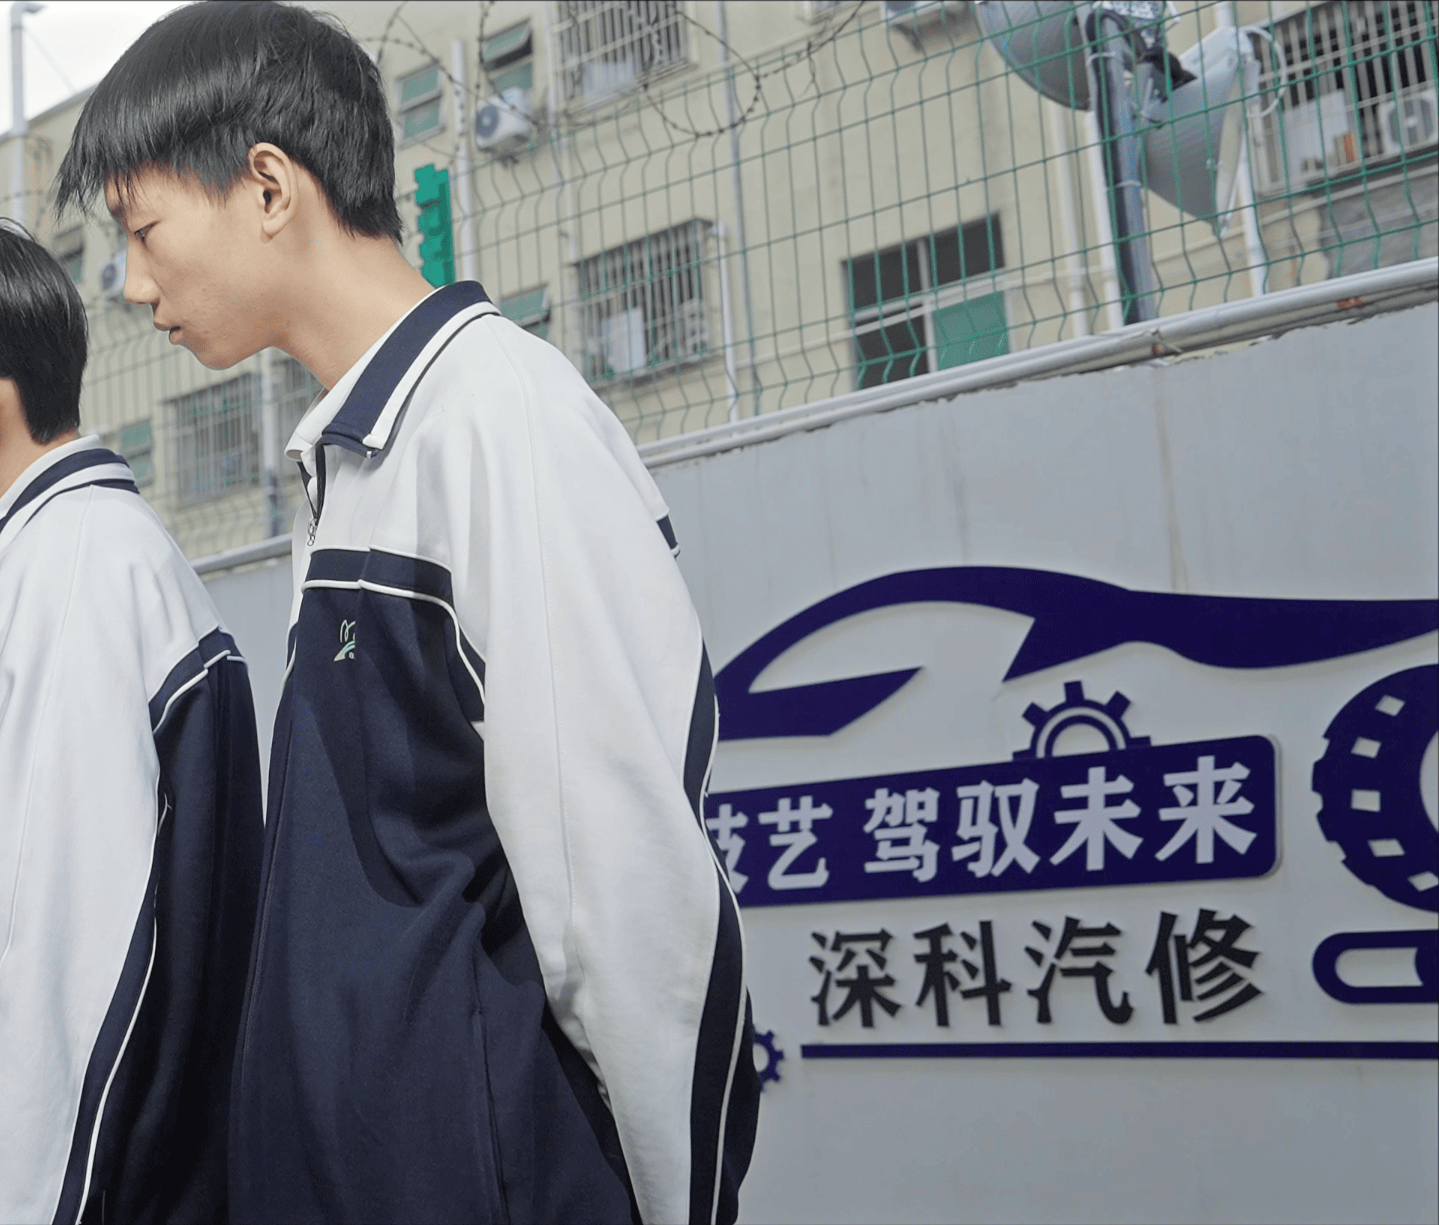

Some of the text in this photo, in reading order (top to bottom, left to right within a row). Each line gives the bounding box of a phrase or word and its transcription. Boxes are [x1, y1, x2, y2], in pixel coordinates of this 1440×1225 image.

[863, 755, 1258, 883] 驾驭未来
[808, 907, 1264, 1029] 深科汽修
